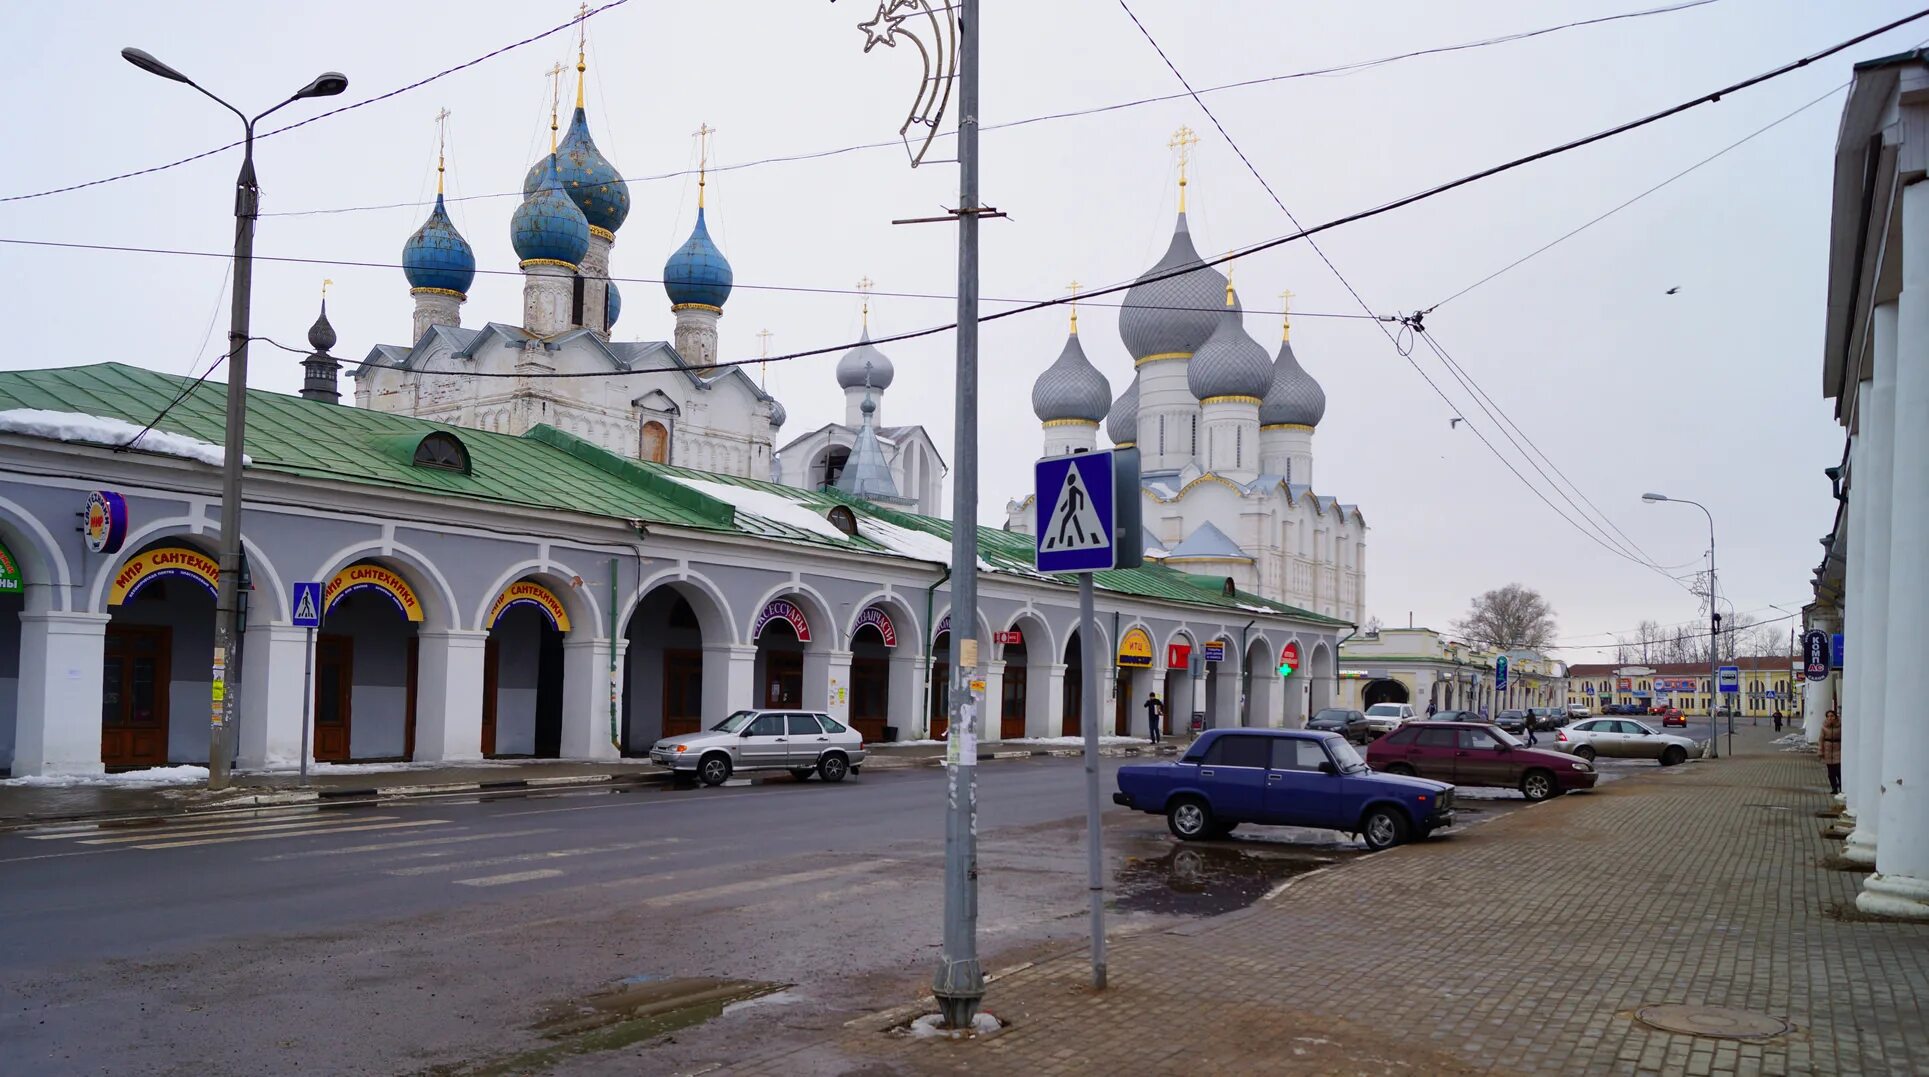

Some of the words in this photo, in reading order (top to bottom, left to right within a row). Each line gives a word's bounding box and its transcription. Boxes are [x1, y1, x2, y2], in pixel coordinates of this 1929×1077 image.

[90, 515, 104, 528] МИР
[116, 562, 144, 589] МИР
[151, 552, 219, 583] САНТЕХНИ
[350, 569, 415, 608] САНТЕХНИКИ
[511, 585, 563, 618] САНТЕХНИКИ
[853, 610, 894, 641] ОЗАПЧАСТИ
